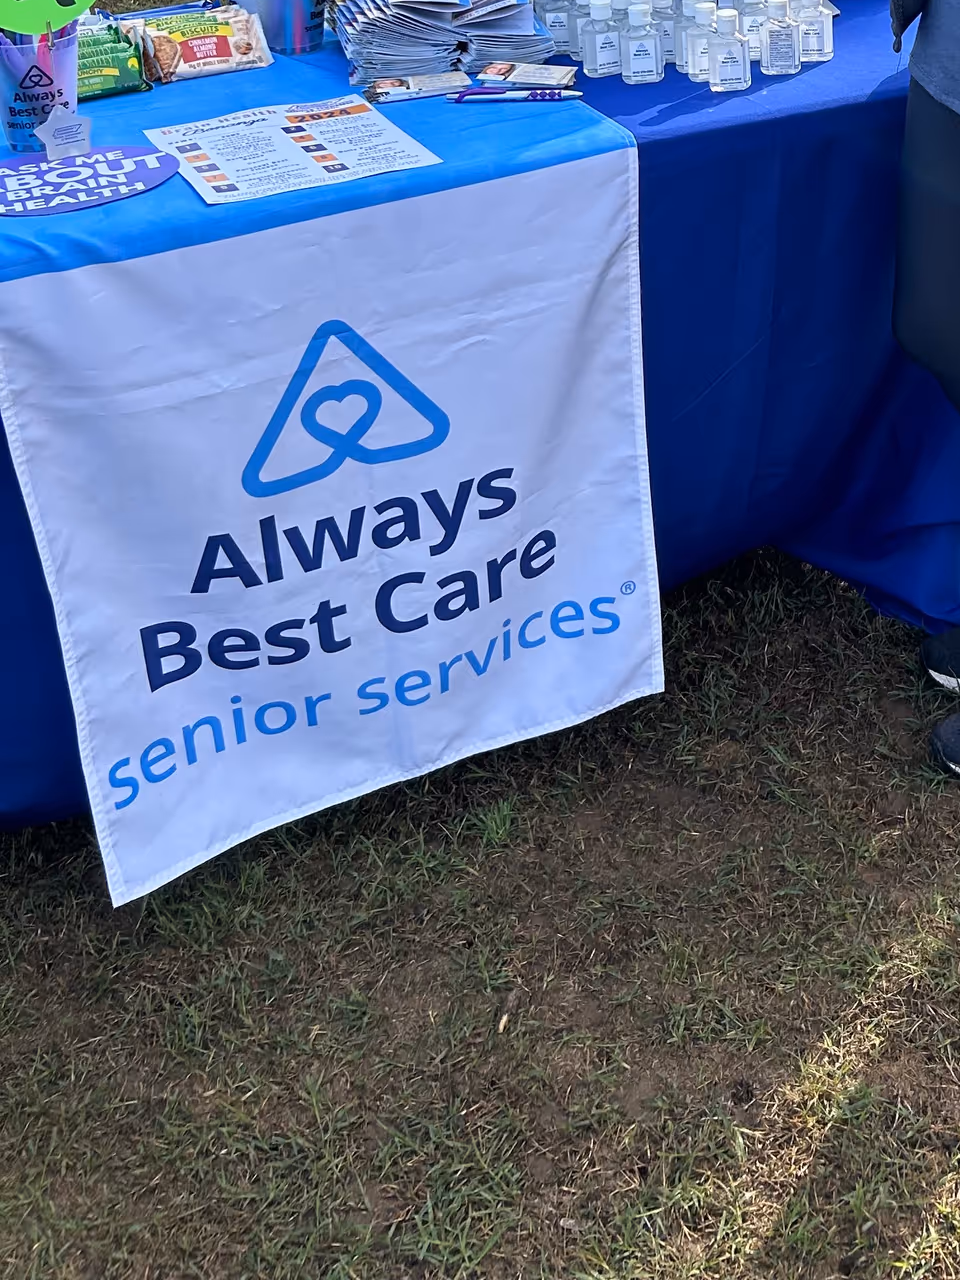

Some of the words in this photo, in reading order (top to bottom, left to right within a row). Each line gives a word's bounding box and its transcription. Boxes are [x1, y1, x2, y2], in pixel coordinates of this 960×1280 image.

[180, 25, 220, 37] BISCUITS
[196, 50, 218, 58] BUTTER
[14, 88, 64, 104] Always
[9, 104, 38, 118] Best
[294, 109, 352, 123] 2024
[7, 119, 36, 130] senior
[0, 159, 69, 176] ASK
[76, 150, 125, 166] ME
[0, 152, 167, 193] BOUT
[0, 182, 146, 214] HEALTH
[6, 174, 128, 202] BRAIN
[190, 467, 518, 594] Always
[139, 598, 352, 694] Best
[374, 528, 558, 634] Care
[108, 689, 332, 811] senior
